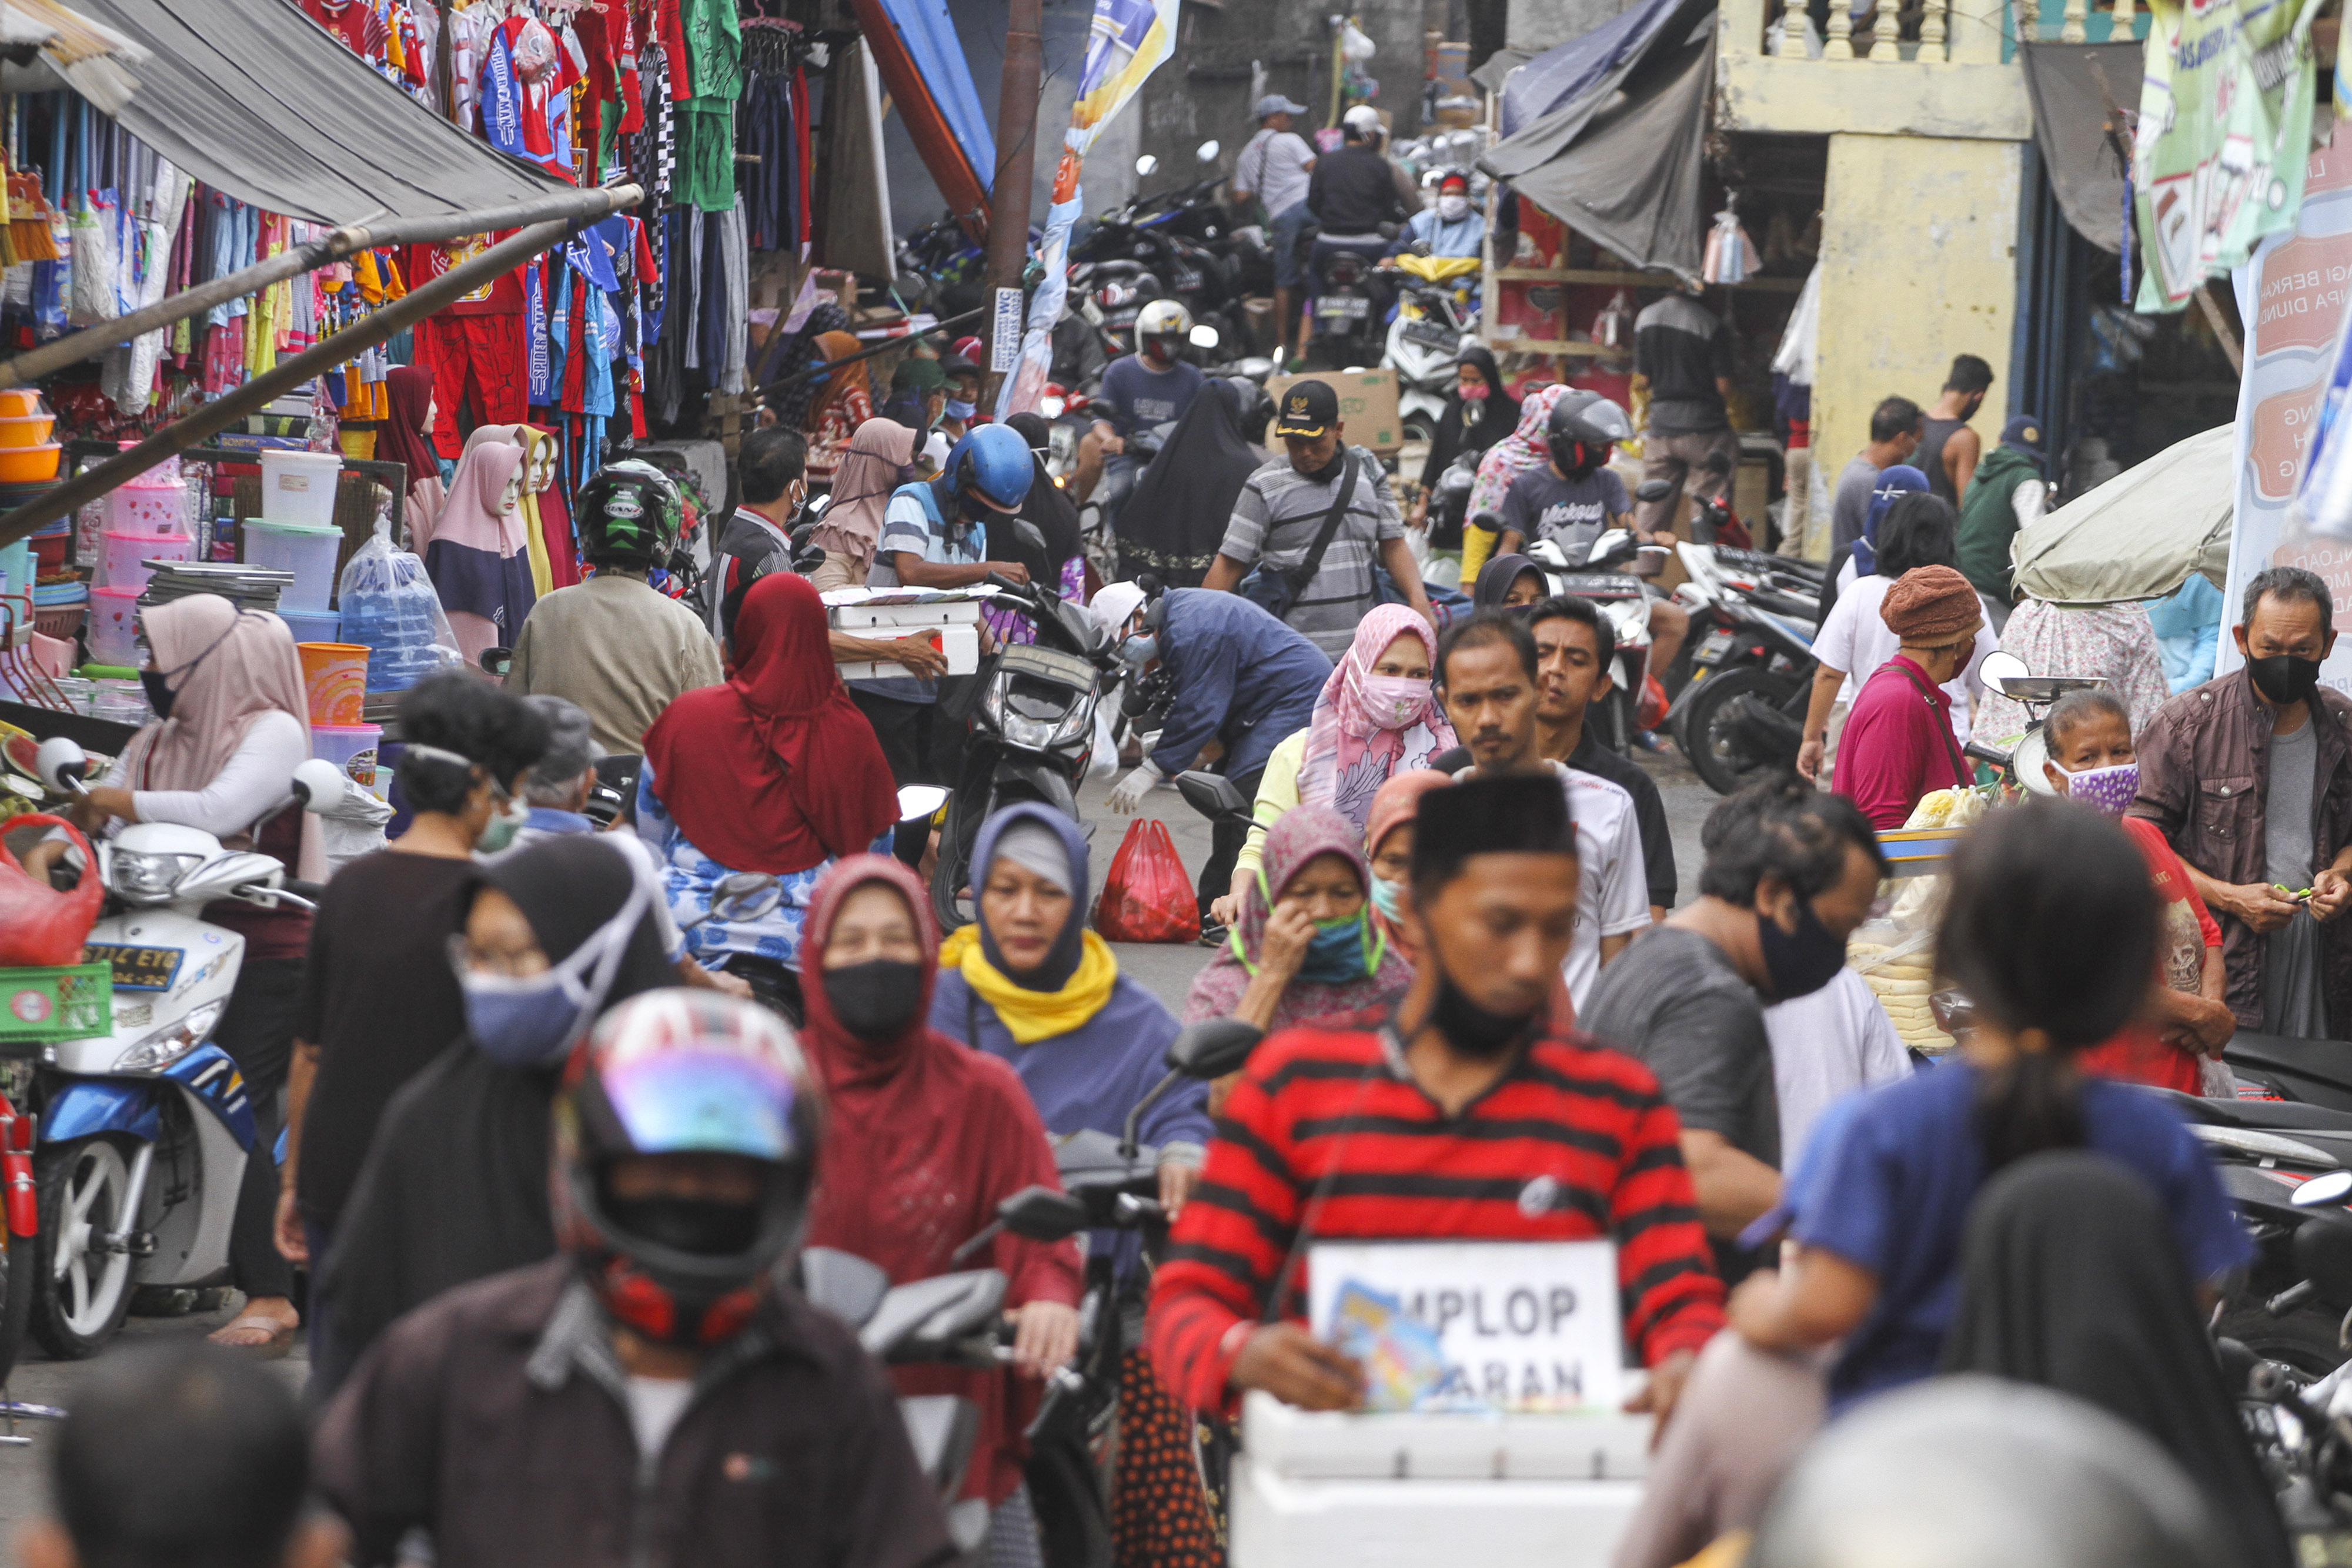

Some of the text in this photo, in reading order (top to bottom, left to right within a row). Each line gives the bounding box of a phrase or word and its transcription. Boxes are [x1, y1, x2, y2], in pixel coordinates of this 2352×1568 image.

[492, 46, 513, 127] SPIDER MAN
[1000, 291, 1011, 314] WC
[532, 339, 547, 378] SPIDER
